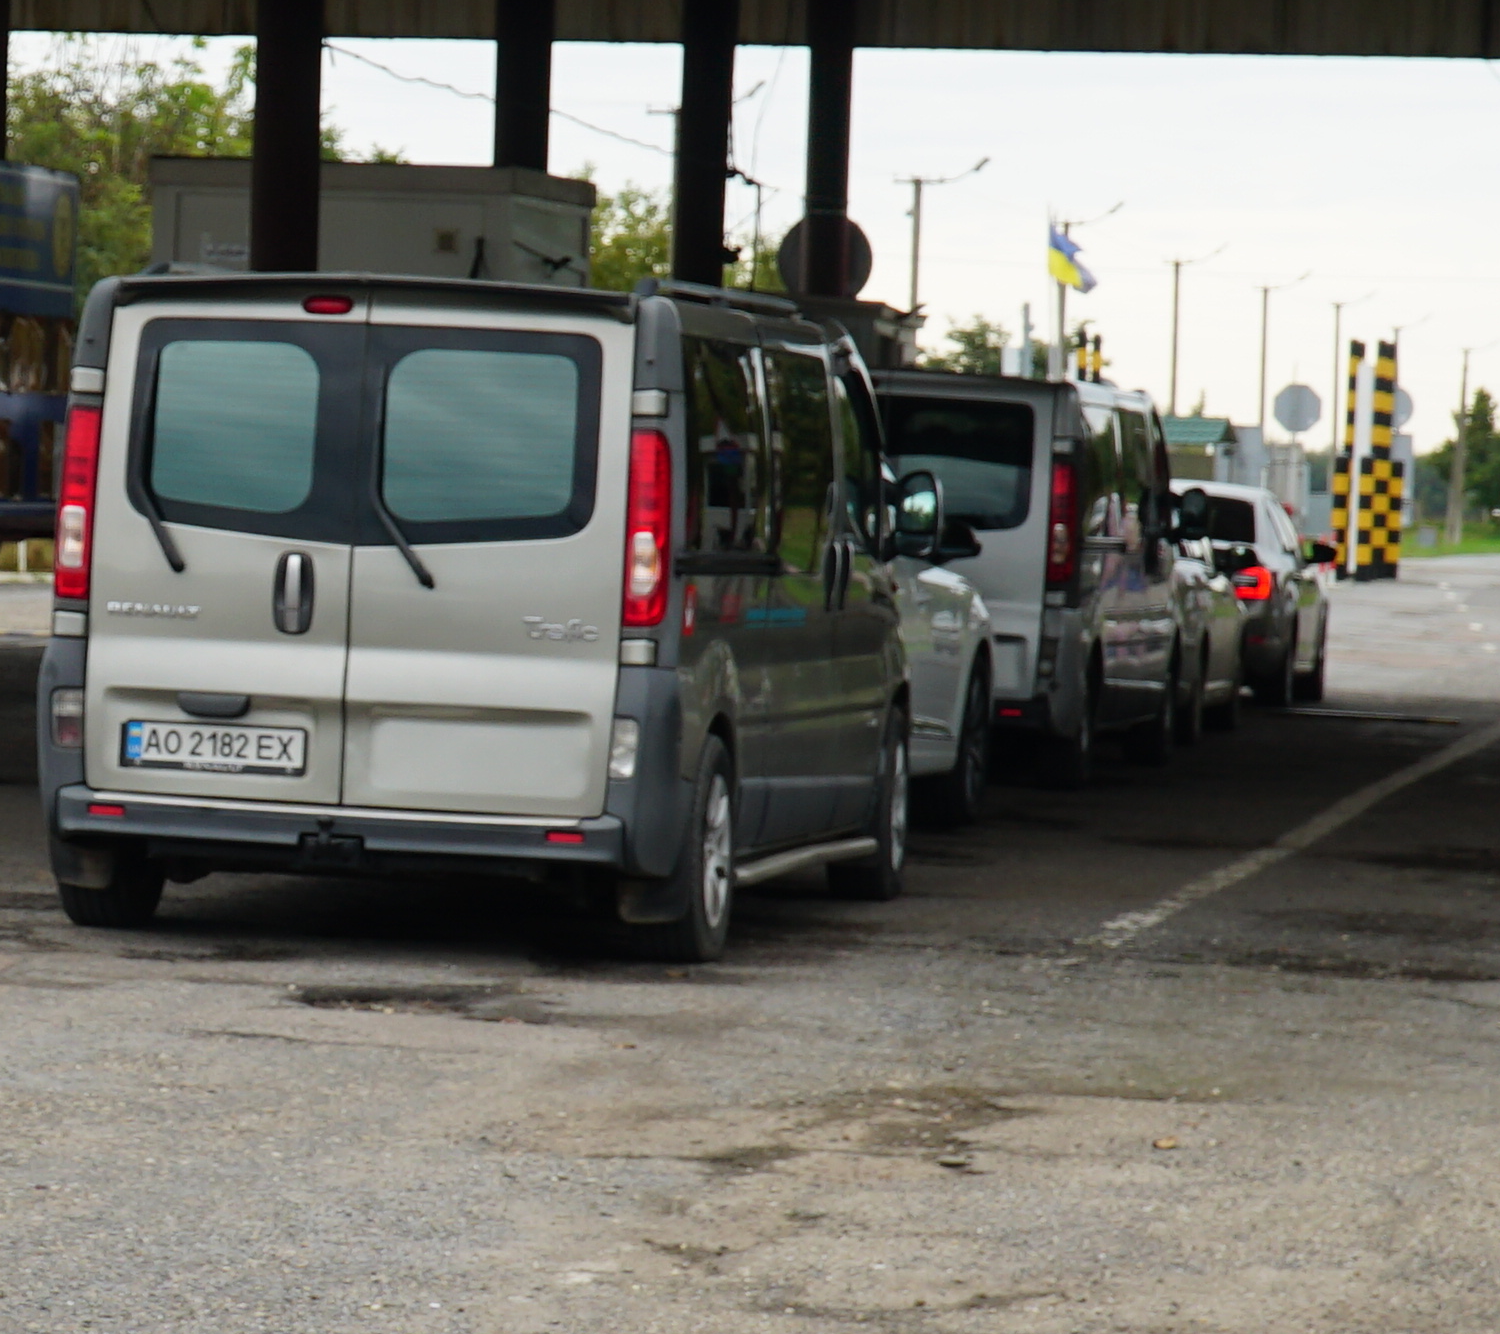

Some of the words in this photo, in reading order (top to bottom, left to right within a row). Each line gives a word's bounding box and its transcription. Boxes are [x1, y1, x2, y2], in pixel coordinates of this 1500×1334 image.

[145, 729, 182, 755] AO
[188, 731, 250, 759] 2182
[256, 734, 294, 762] EX
